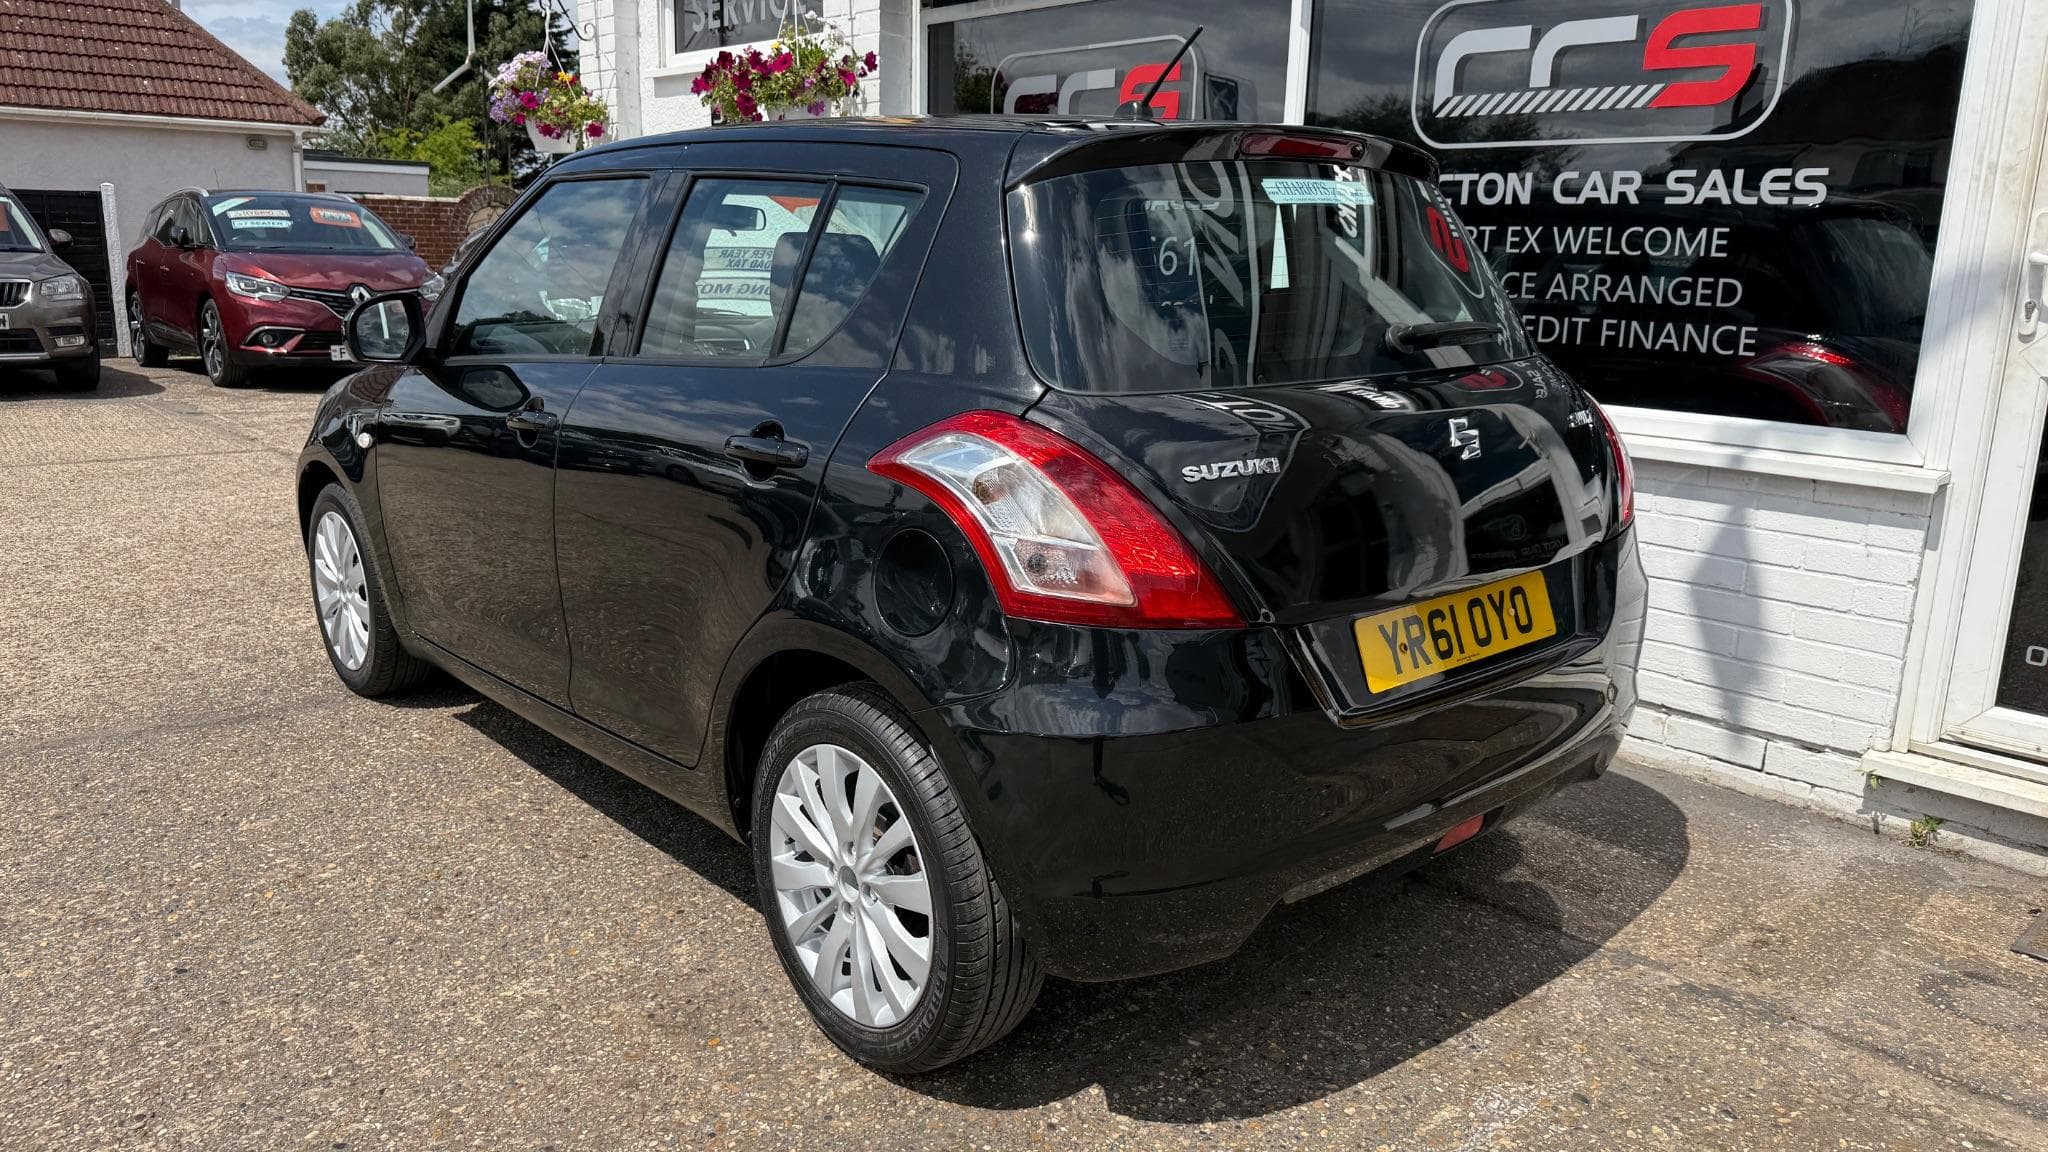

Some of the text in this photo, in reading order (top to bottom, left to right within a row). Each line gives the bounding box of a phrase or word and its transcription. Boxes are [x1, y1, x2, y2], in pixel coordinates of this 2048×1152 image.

[1433, 3, 1762, 118] CCS
[1552, 170, 1643, 205] CAR
[1664, 167, 1830, 206] SALES
[1505, 226, 1543, 254] EX
[1552, 226, 1730, 258] WELCOME
[1544, 272, 1743, 307] ARRANGED
[1599, 318, 1759, 357] FINANCE
[1182, 456, 1281, 484] SUZUKI
[1377, 585, 1534, 675] YR61 OYO
